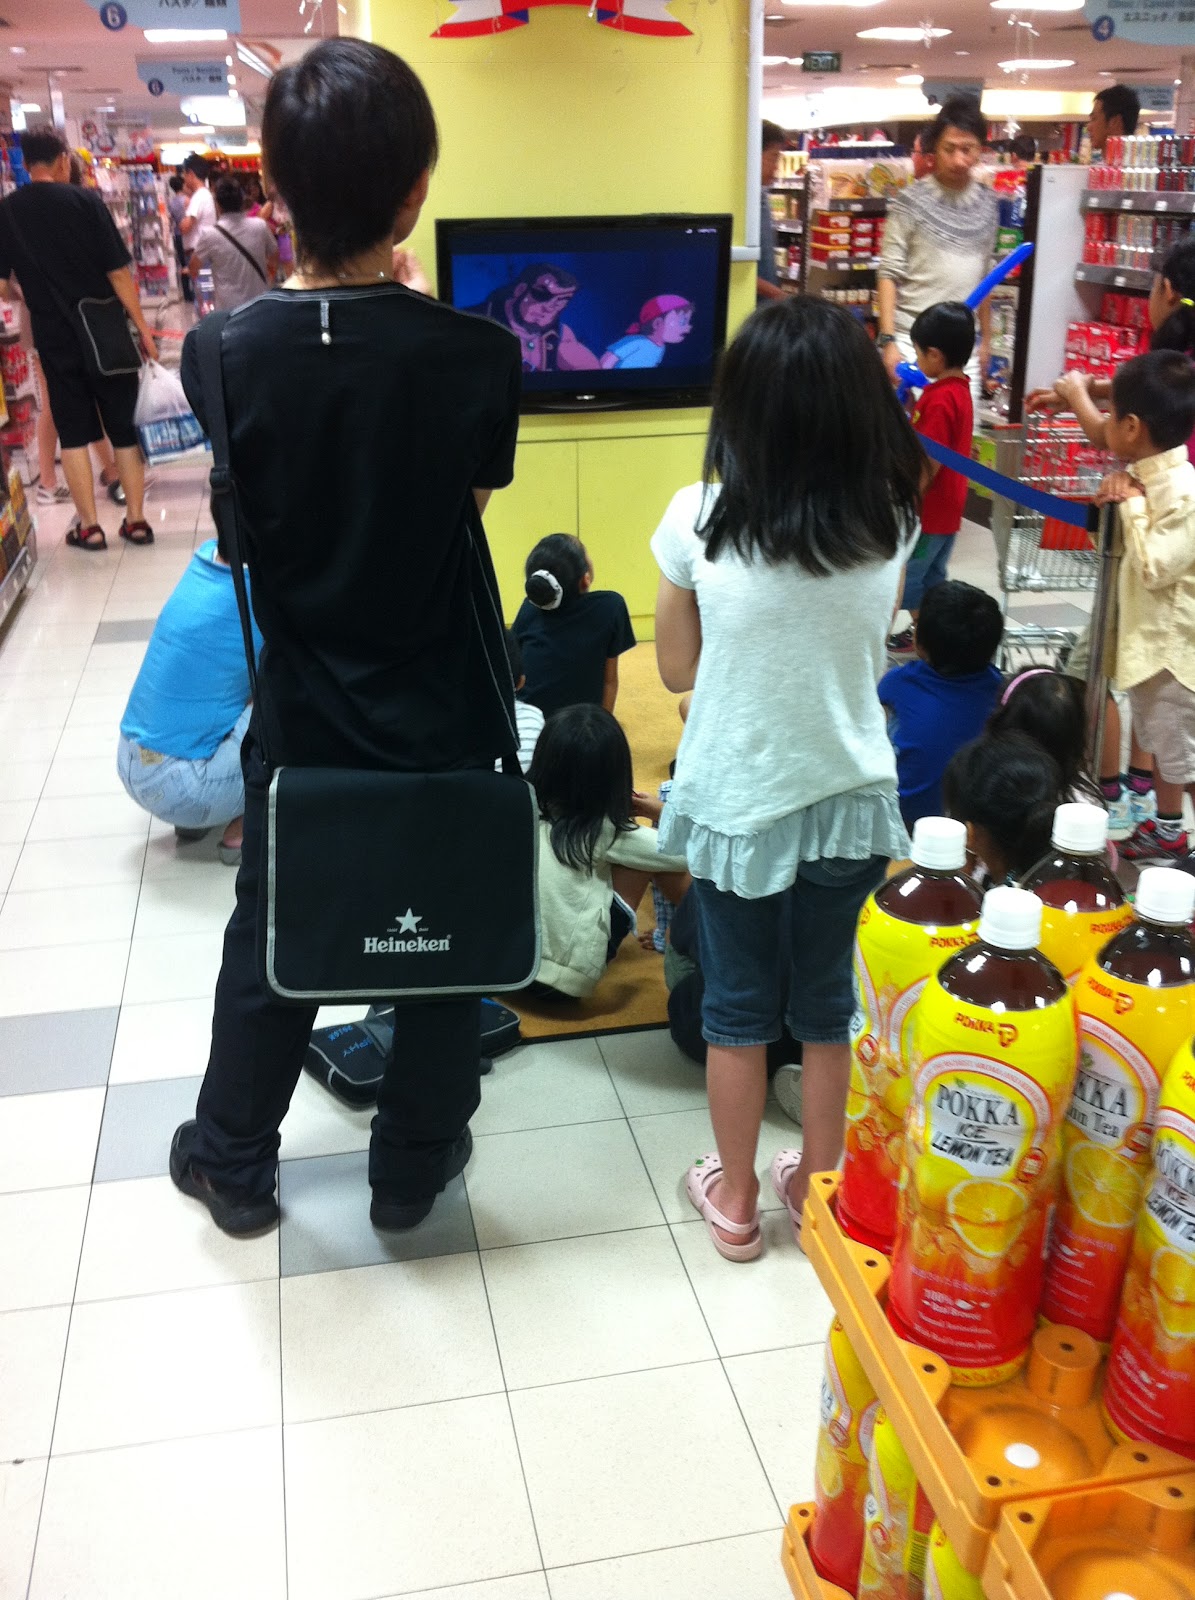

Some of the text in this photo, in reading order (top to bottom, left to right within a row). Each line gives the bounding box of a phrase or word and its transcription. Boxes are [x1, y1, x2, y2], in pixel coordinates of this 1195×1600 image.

[363, 935, 451, 954] Heineken
[954, 1012, 995, 1035] POKKA
[936, 1083, 1020, 1127] POKKA
[957, 1122, 989, 1139] ICE
[1092, 1111, 1120, 1139] Tea
[931, 1131, 983, 1163] LEMON
[984, 1145, 1016, 1167] TEA
